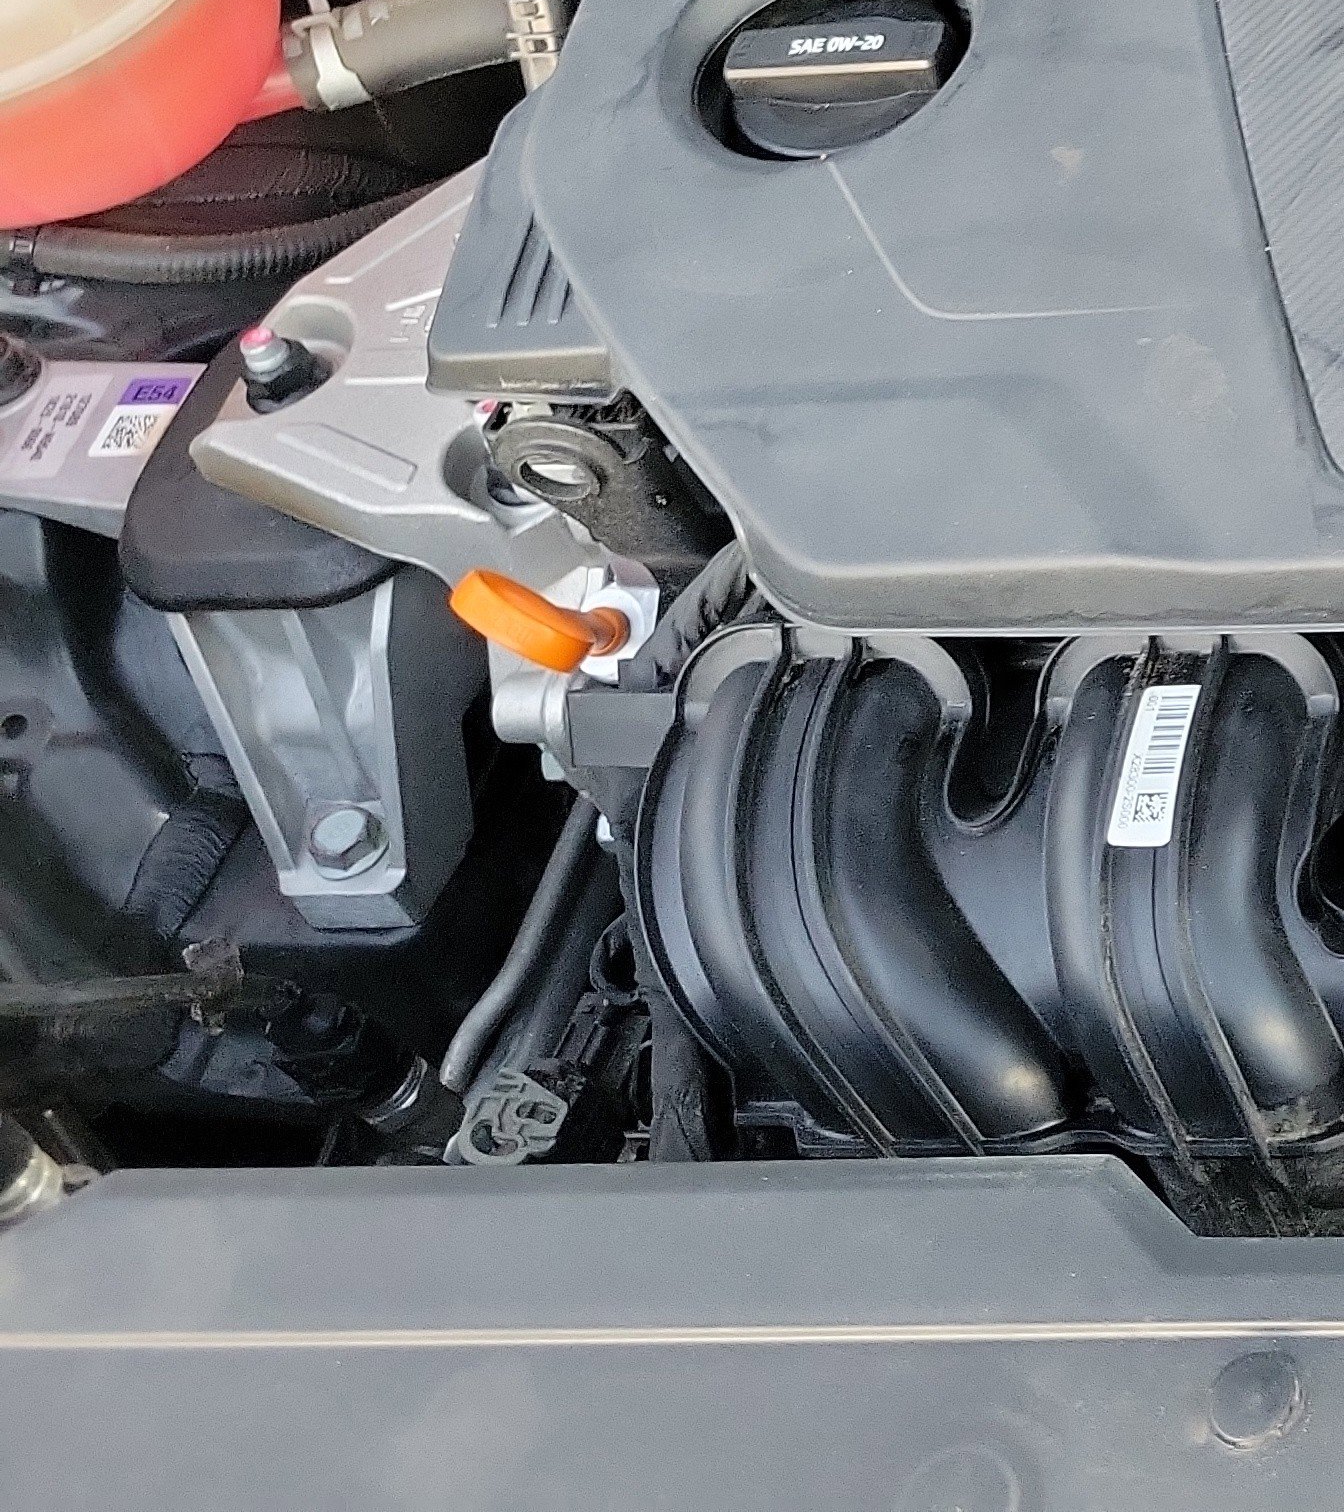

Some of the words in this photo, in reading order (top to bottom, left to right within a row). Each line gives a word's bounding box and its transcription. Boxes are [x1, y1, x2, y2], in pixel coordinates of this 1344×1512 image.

[788, 37, 824, 56] SAE
[826, 34, 886, 54] 0W-20
[132, 384, 178, 402] E54
